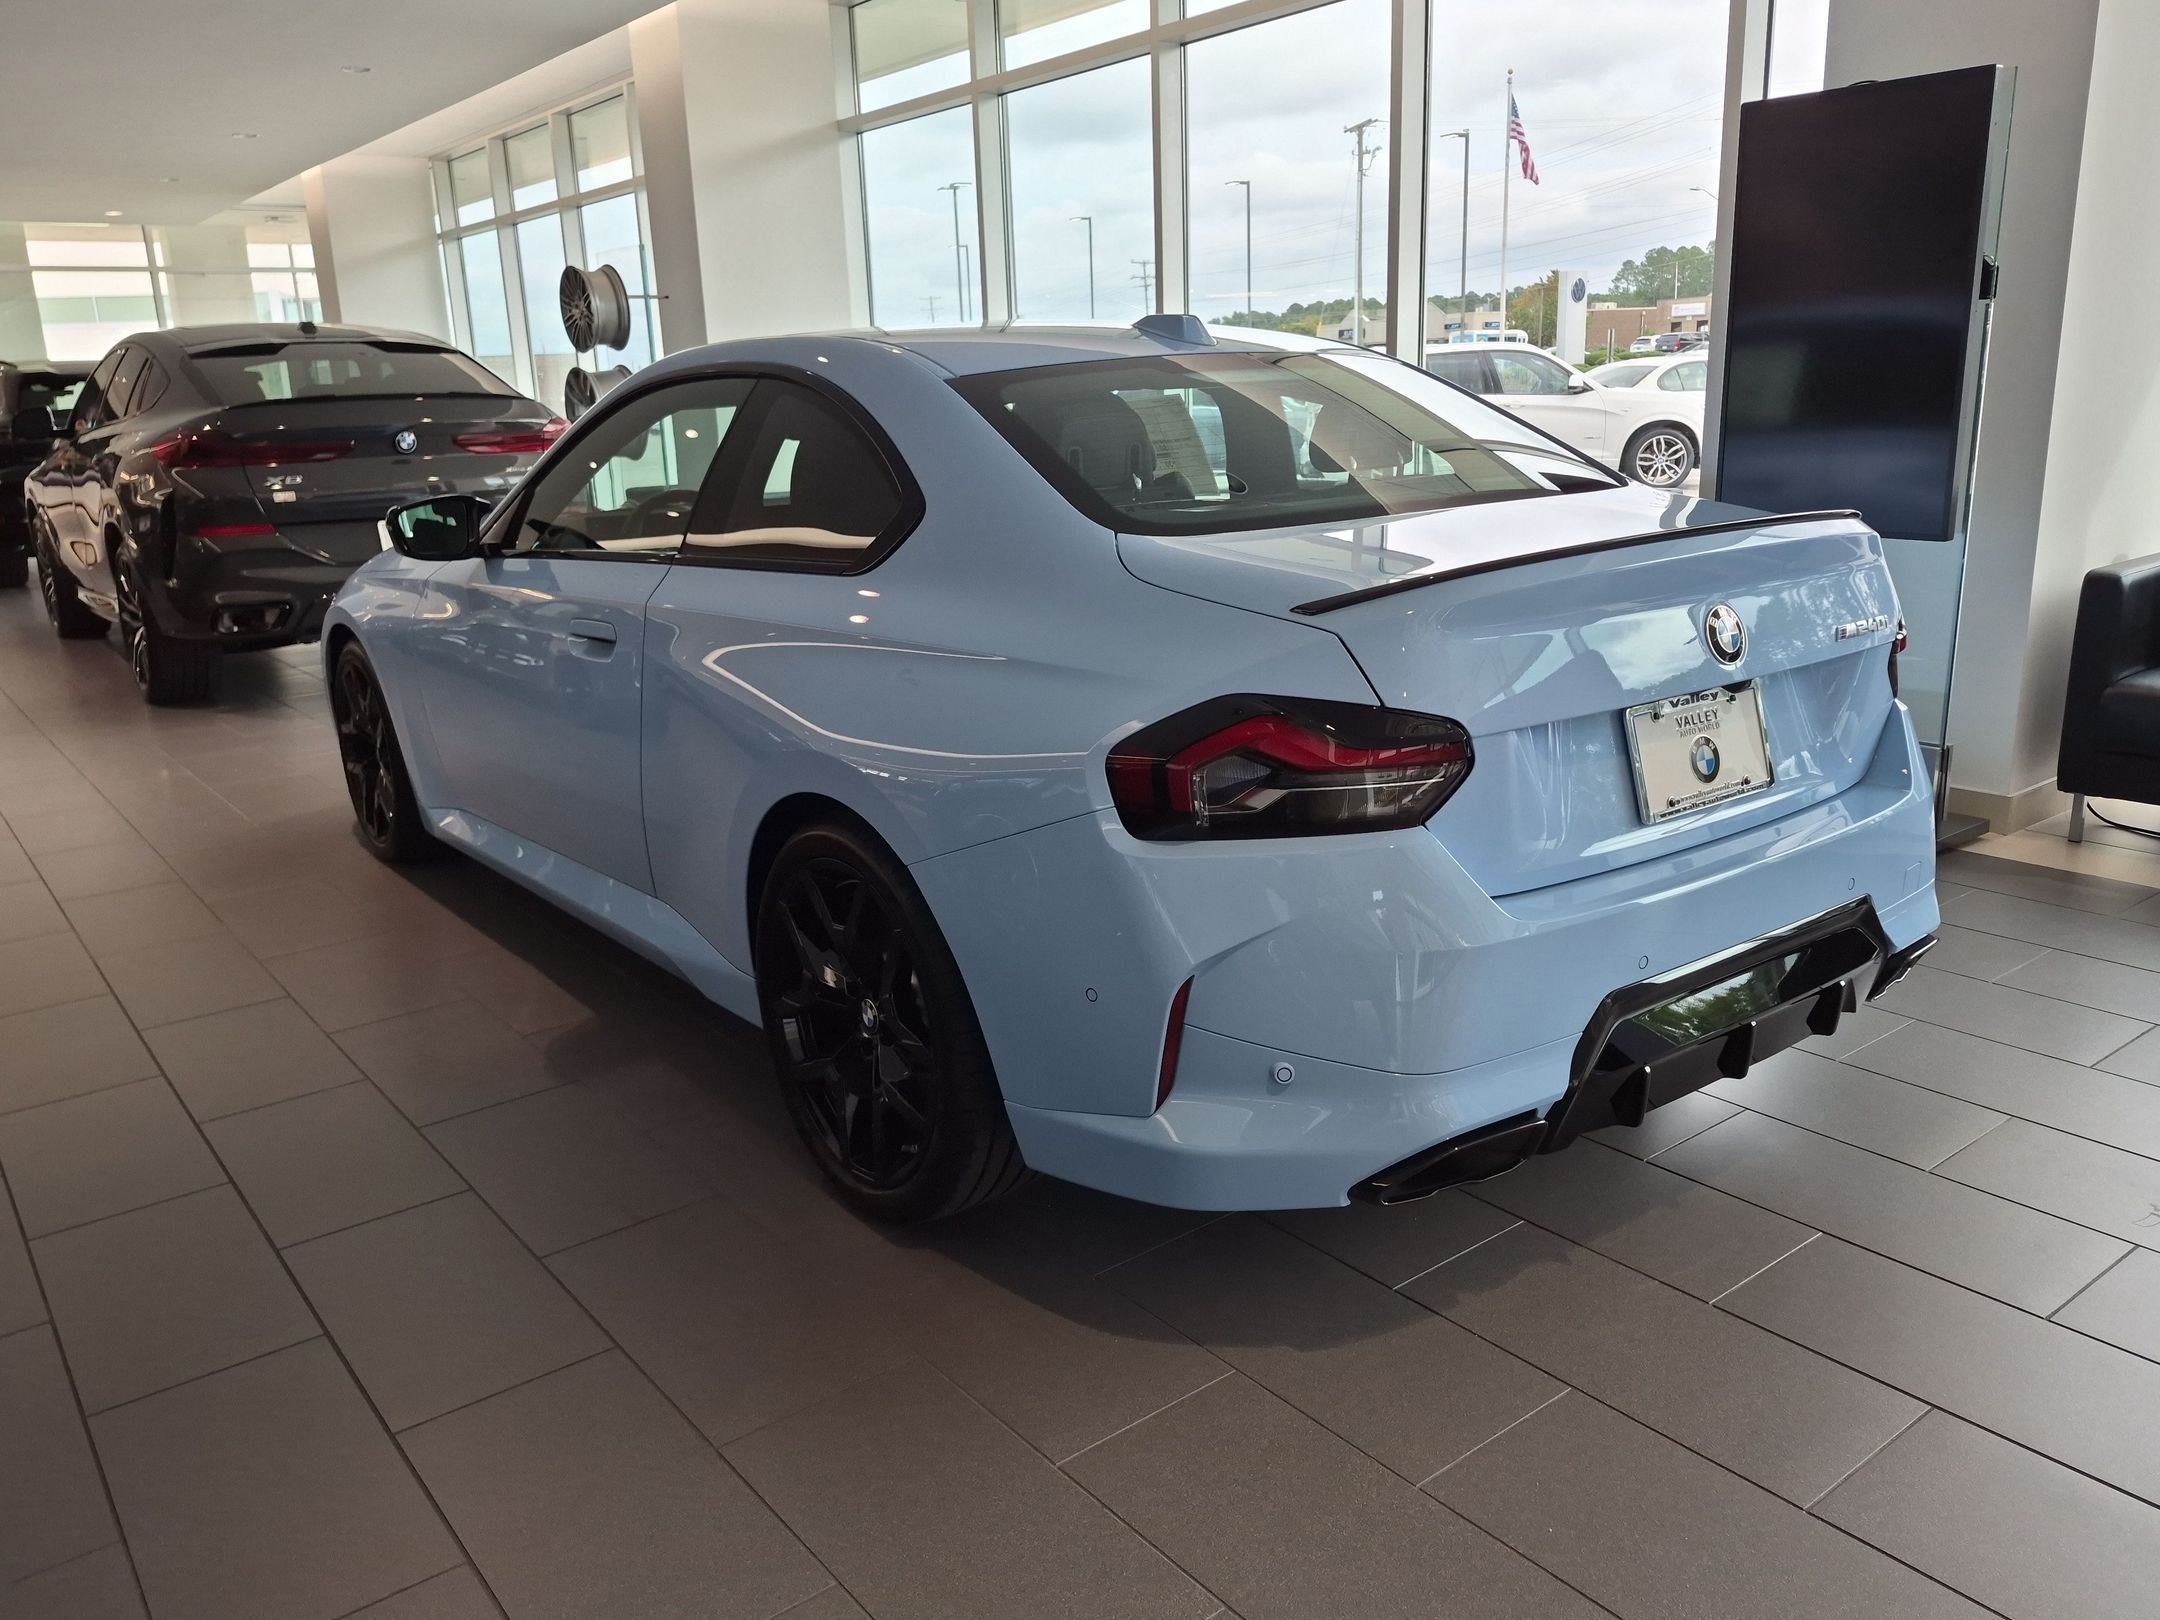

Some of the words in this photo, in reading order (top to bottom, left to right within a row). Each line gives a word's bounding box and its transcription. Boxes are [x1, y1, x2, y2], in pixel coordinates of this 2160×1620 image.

[1668, 690, 1719, 709] Valley
[1675, 708, 1719, 729] VALLEY
[1679, 726, 1697, 738] AUTO
[1697, 721, 1721, 733] WORLD
